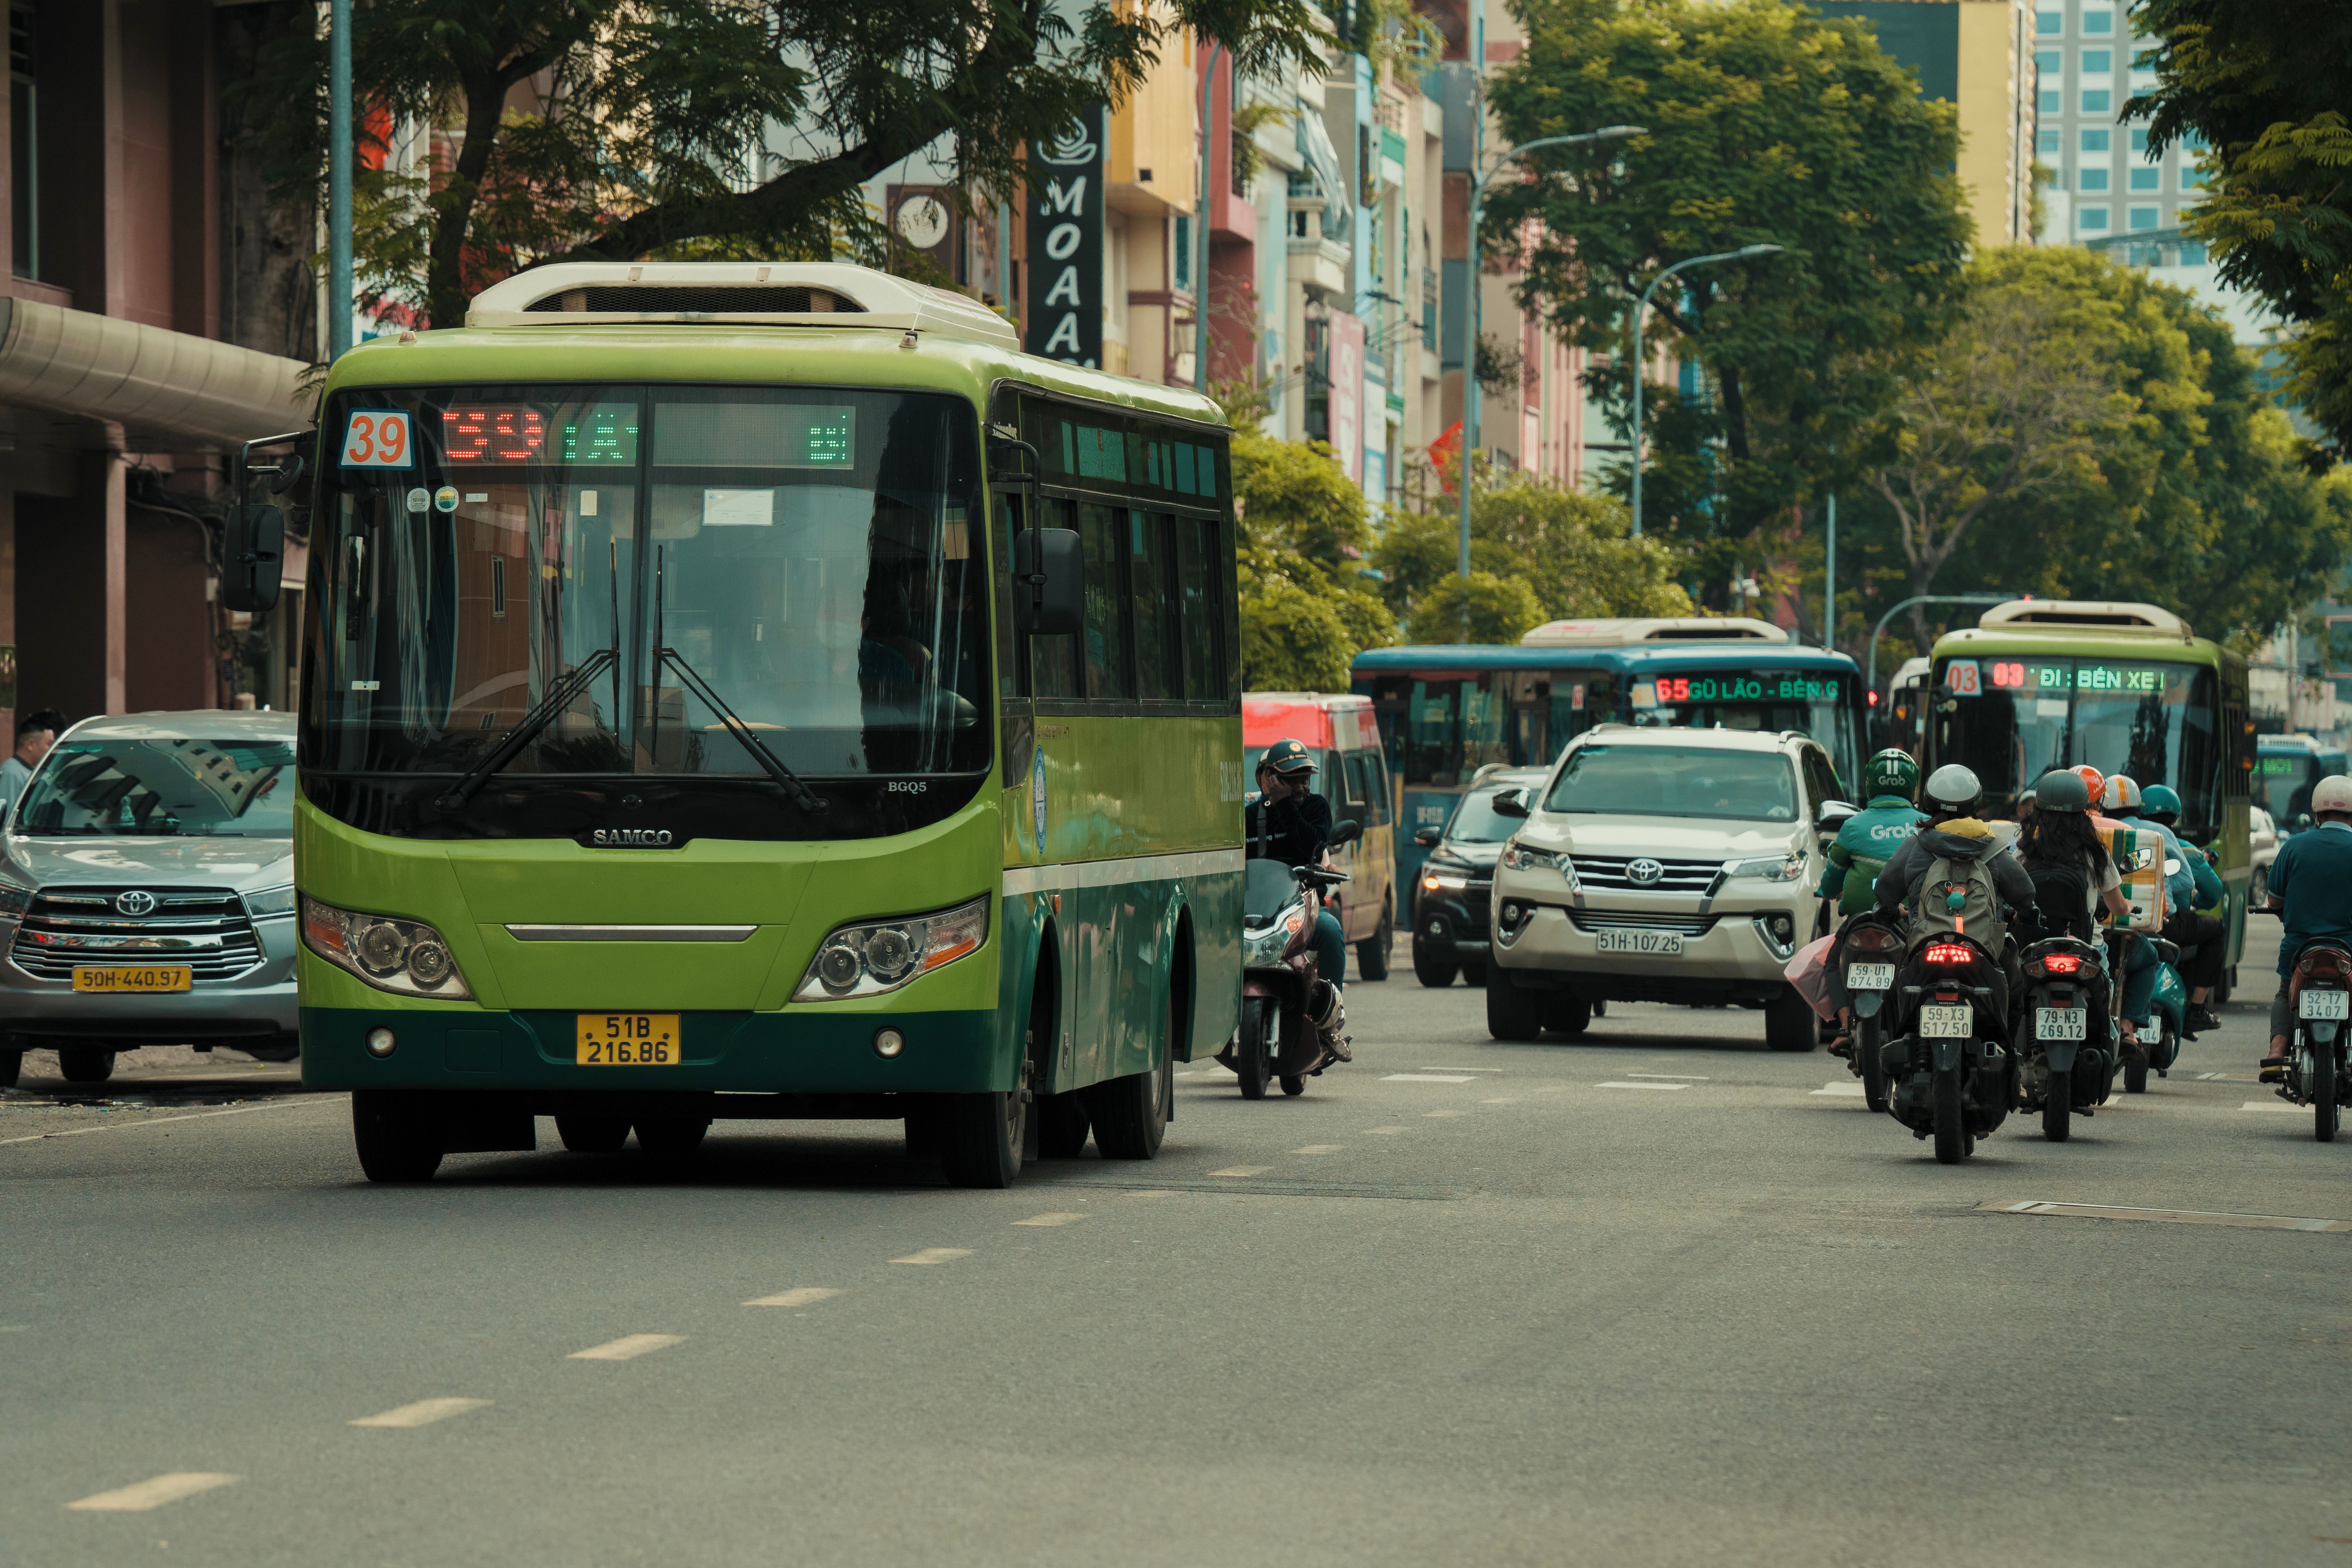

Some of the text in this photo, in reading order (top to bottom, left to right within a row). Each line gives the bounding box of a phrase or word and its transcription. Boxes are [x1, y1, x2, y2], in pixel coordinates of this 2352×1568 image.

[1040, 175, 1096, 368] MOAA
[348, 415, 406, 463] 39
[1947, 666, 1977, 693] 03
[1994, 662, 2024, 687] 03
[2127, 671, 2154, 690] XE
[1656, 678, 1689, 701] 65
[888, 782, 927, 794] BGQ5
[1220, 761, 1242, 802] 51B-216.86
[1878, 775, 1906, 786] Grab
[593, 829, 672, 845] SAMCO
[1871, 822, 1919, 840] Grab
[1600, 933, 1679, 952] 51H-107.25
[1856, 965, 1886, 976] 59-U1
[83, 971, 181, 986] 50H-440.97
[1851, 976, 1889, 987] 974.89
[2308, 993, 2341, 1004] 52-T7
[1928, 1008, 1964, 1020] 59-X3
[2045, 1011, 2077, 1024] 79-N3
[2307, 1005, 2341, 1017] 3407
[606, 1017, 650, 1038] 51B
[1923, 1022, 1969, 1035] 517.50
[2040, 1024, 2082, 1038] 269.12
[588, 1041, 668, 1062] 216.86
